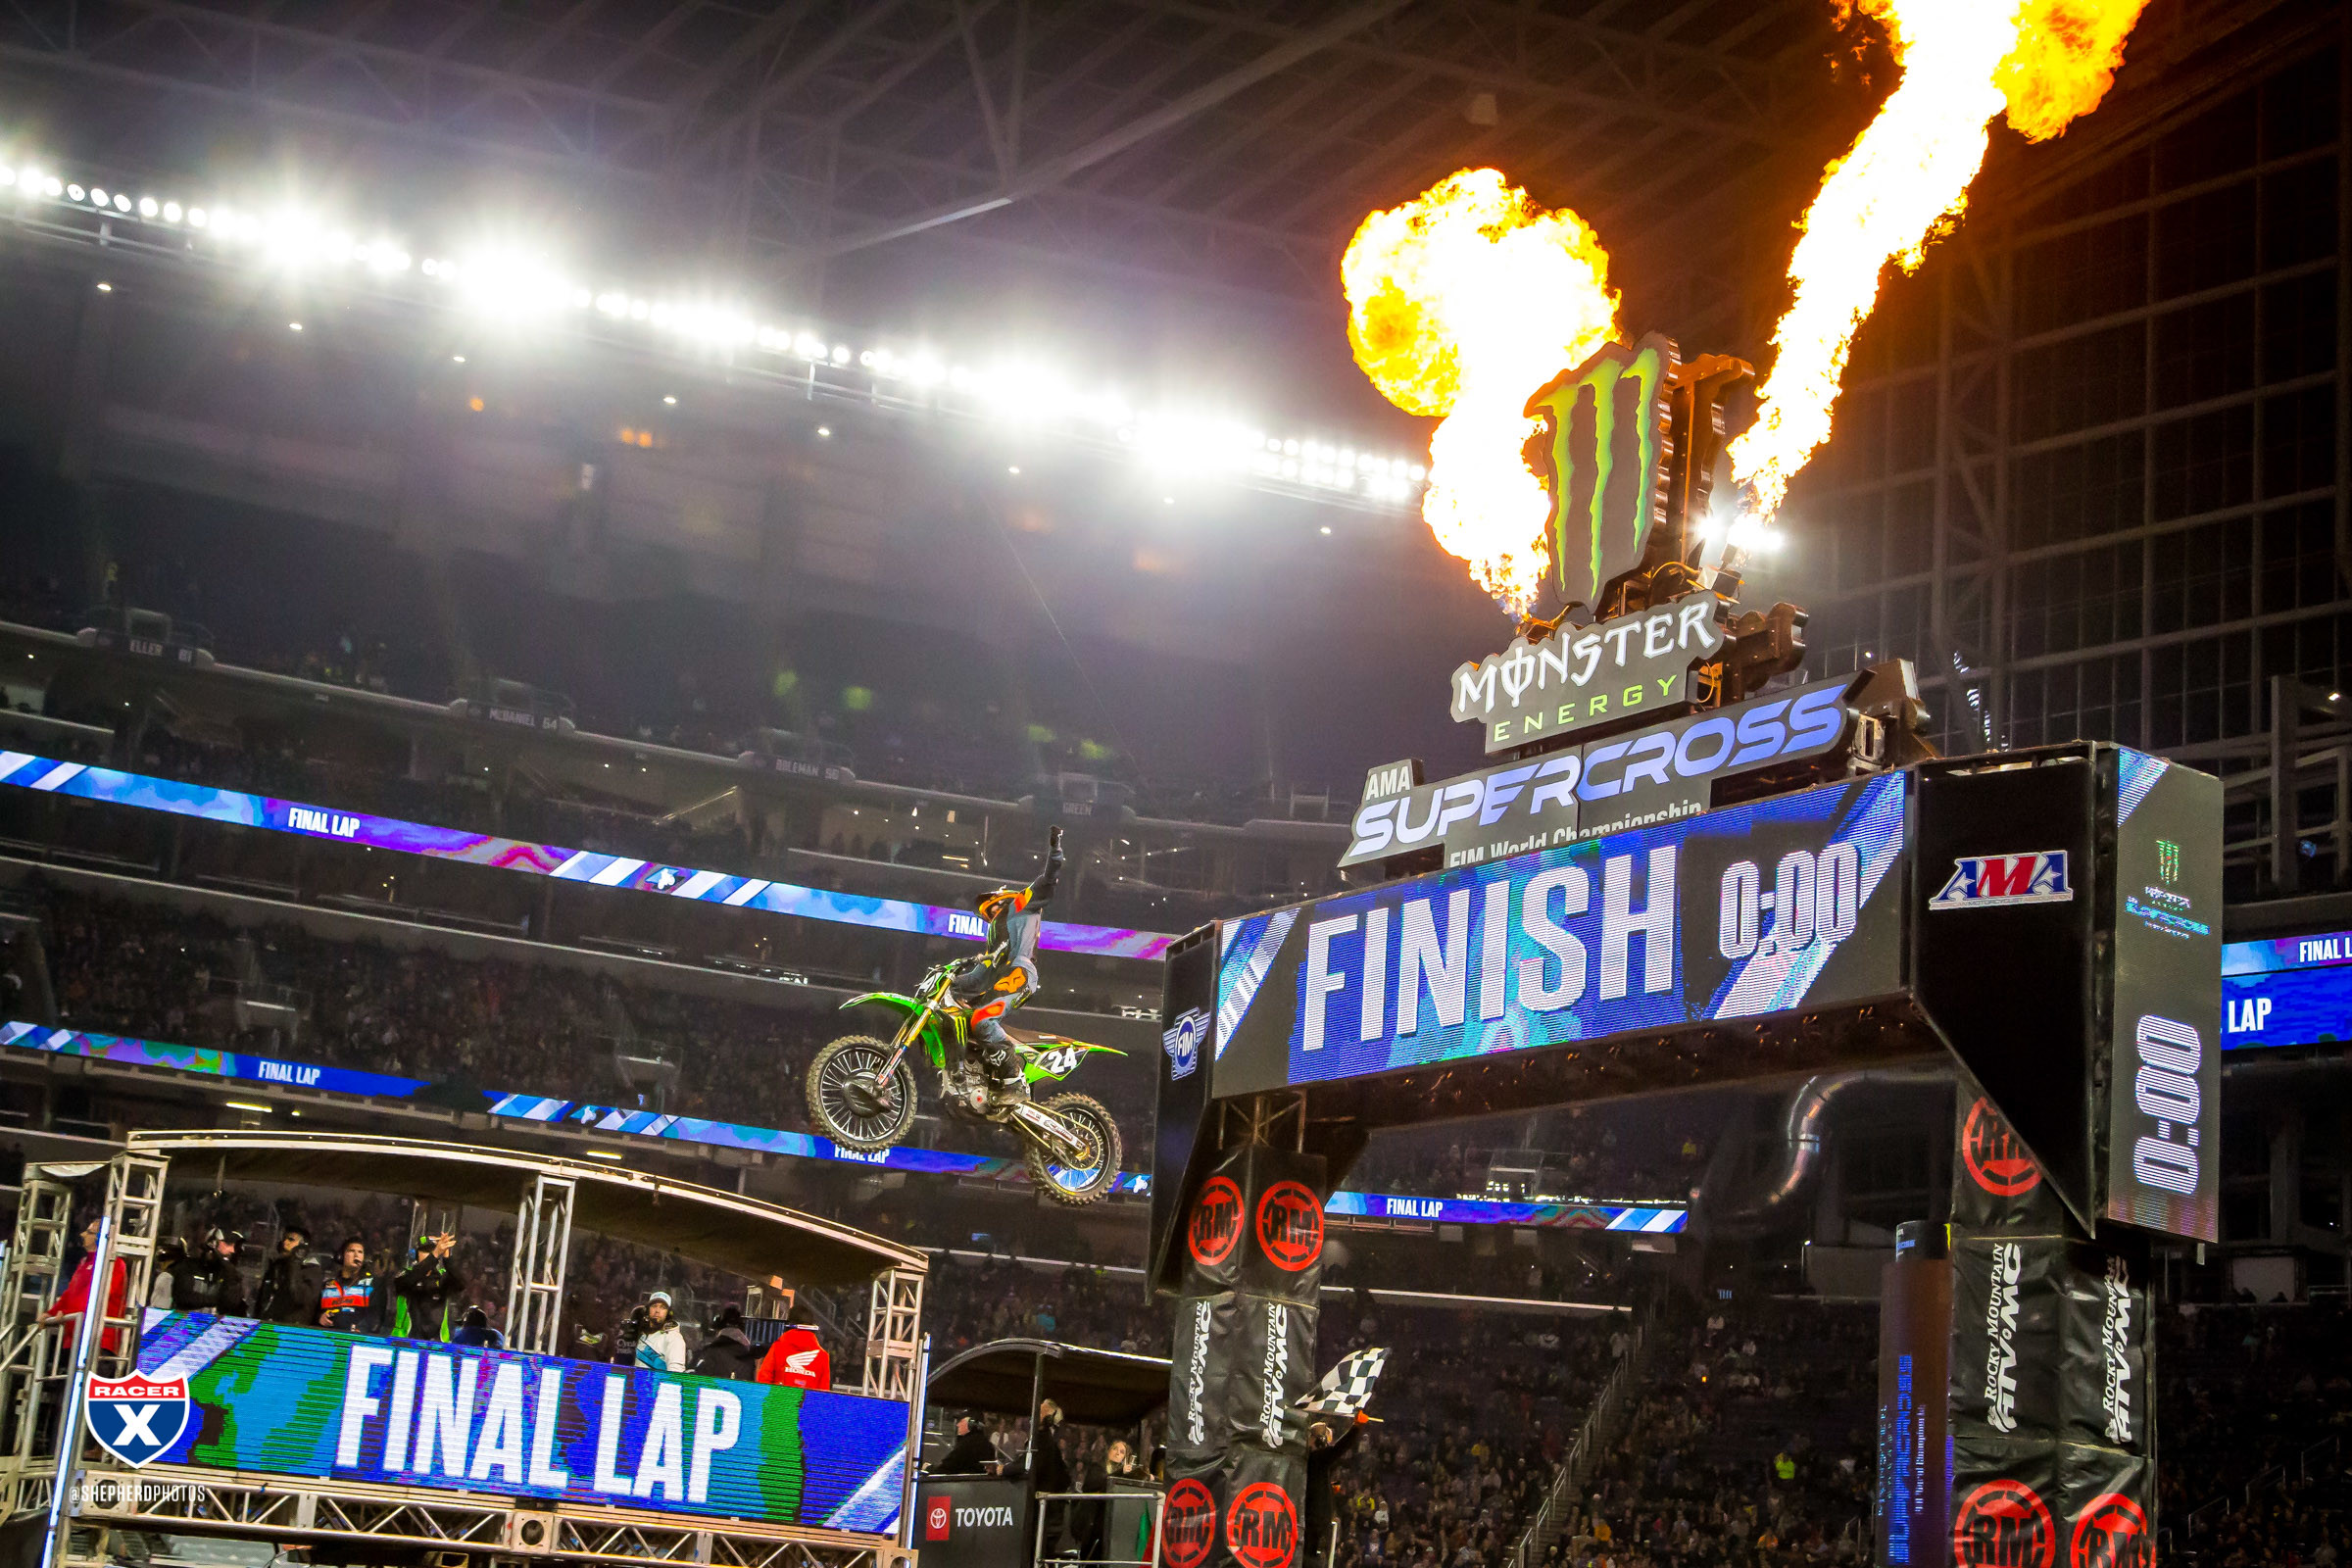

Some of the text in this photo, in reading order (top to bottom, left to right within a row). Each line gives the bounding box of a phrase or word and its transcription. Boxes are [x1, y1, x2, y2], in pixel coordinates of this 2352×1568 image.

[1457, 599, 1717, 714] MONSTER
[1494, 674, 1678, 743] ENERGY
[1348, 684, 1849, 857] SUPERCROSS
[1365, 765, 1413, 802] AMA
[288, 807, 361, 838] FINAL LAP
[1450, 847, 1485, 868] FIM
[1491, 832, 1547, 858] World
[1931, 851, 2069, 903] AMA
[948, 913, 985, 937] FINAL
[1302, 845, 1678, 1052] FINISH
[2299, 938, 2342, 962] FINAL
[2228, 998, 2273, 1033] LAP
[1048, 1047, 1078, 1074] 24
[1177, 1031, 1194, 1057] FIM
[258, 1060, 321, 1086] FINAL LAP
[2132, 1014, 2202, 1195] 0:00
[867, 1148, 891, 1164] LAP
[1386, 1198, 1444, 1218] FINAL LAP
[1984, 1243, 2005, 1402] ROCKY MOUNTAIN
[2101, 1254, 2118, 1414] ROCKY MOUNT
[785, 1366, 816, 1378] HONDA
[1188, 1301, 1203, 1422] ROCKY MOUNTAIN
[1259, 1301, 1276, 1425] ROCKY MOUNTAIN
[335, 1343, 743, 1503] FINAL LAP
[956, 1506, 1013, 1528] TOYOTA
